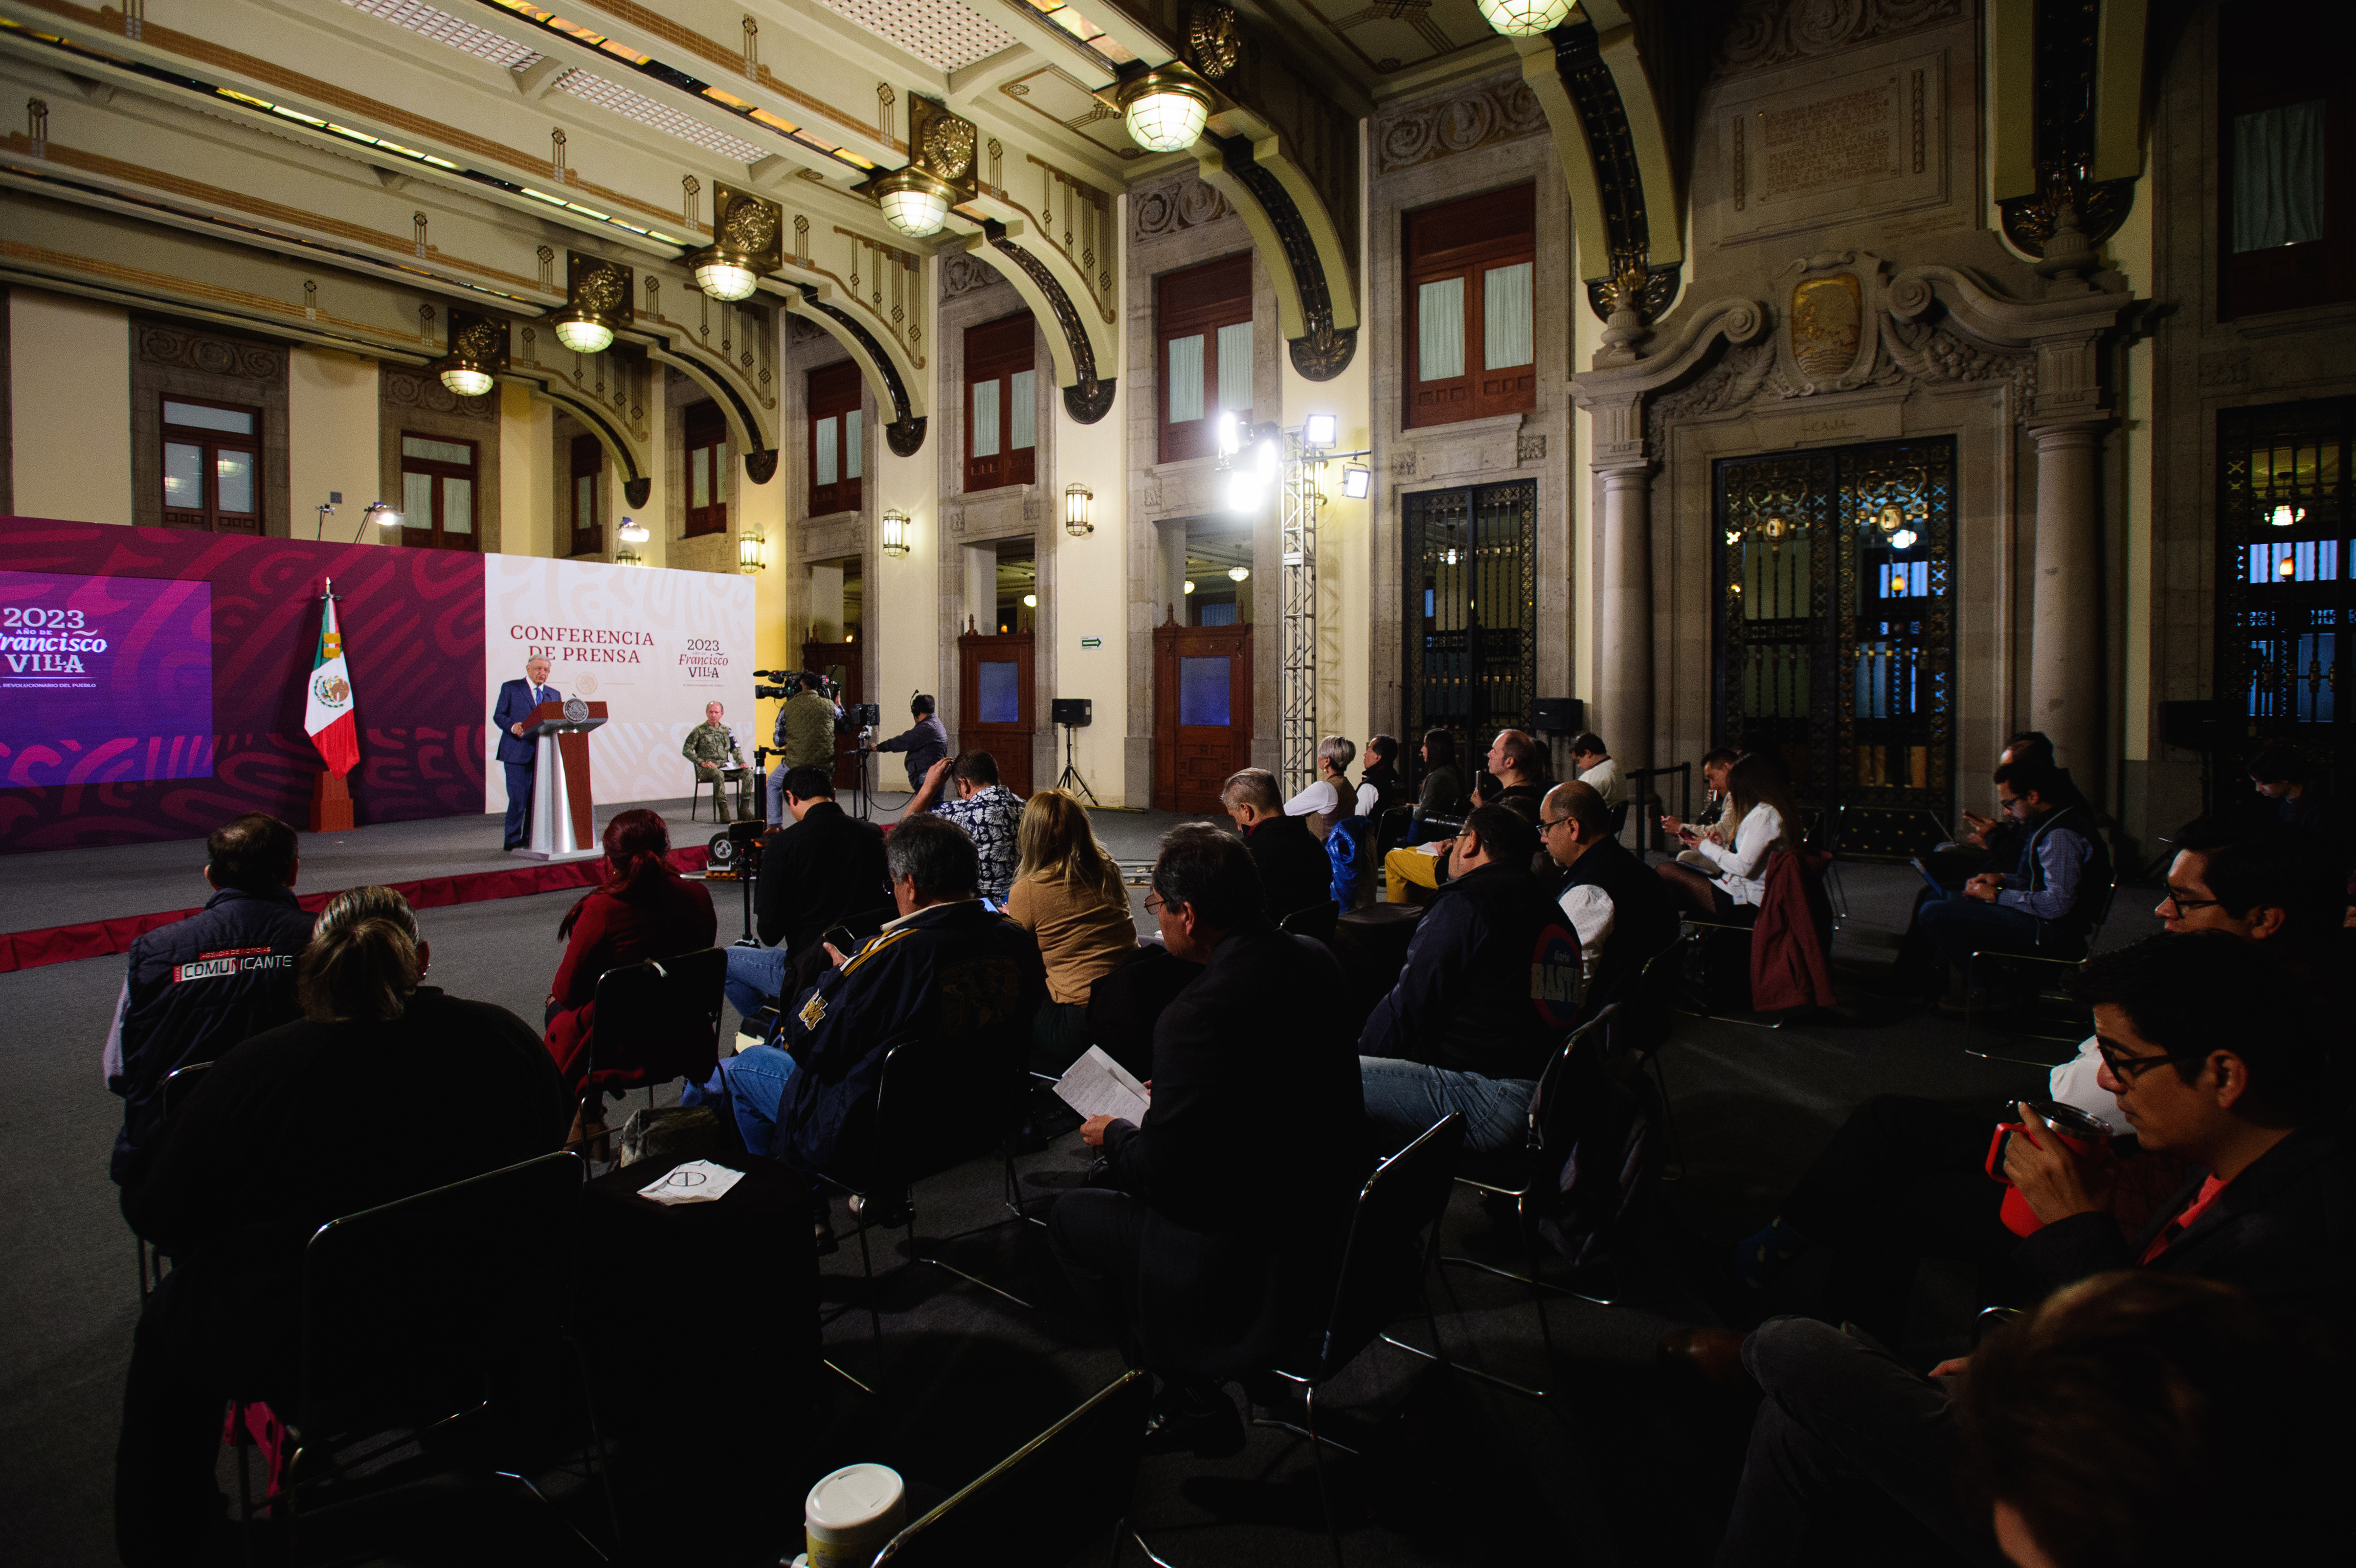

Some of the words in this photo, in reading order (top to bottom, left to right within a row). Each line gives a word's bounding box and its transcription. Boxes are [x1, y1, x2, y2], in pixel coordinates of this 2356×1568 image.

[3, 607, 85, 628] 2023
[510, 625, 654, 646] CONFERENCIA
[528, 645, 556, 660] DE
[562, 647, 641, 663] PRENSA
[687, 639, 719, 651] 2023
[4, 654, 85, 673] VILLA
[678, 653, 728, 666] Francisco
[688, 667, 719, 678] VILLA
[184, 955, 293, 978] COMUNICANTE
